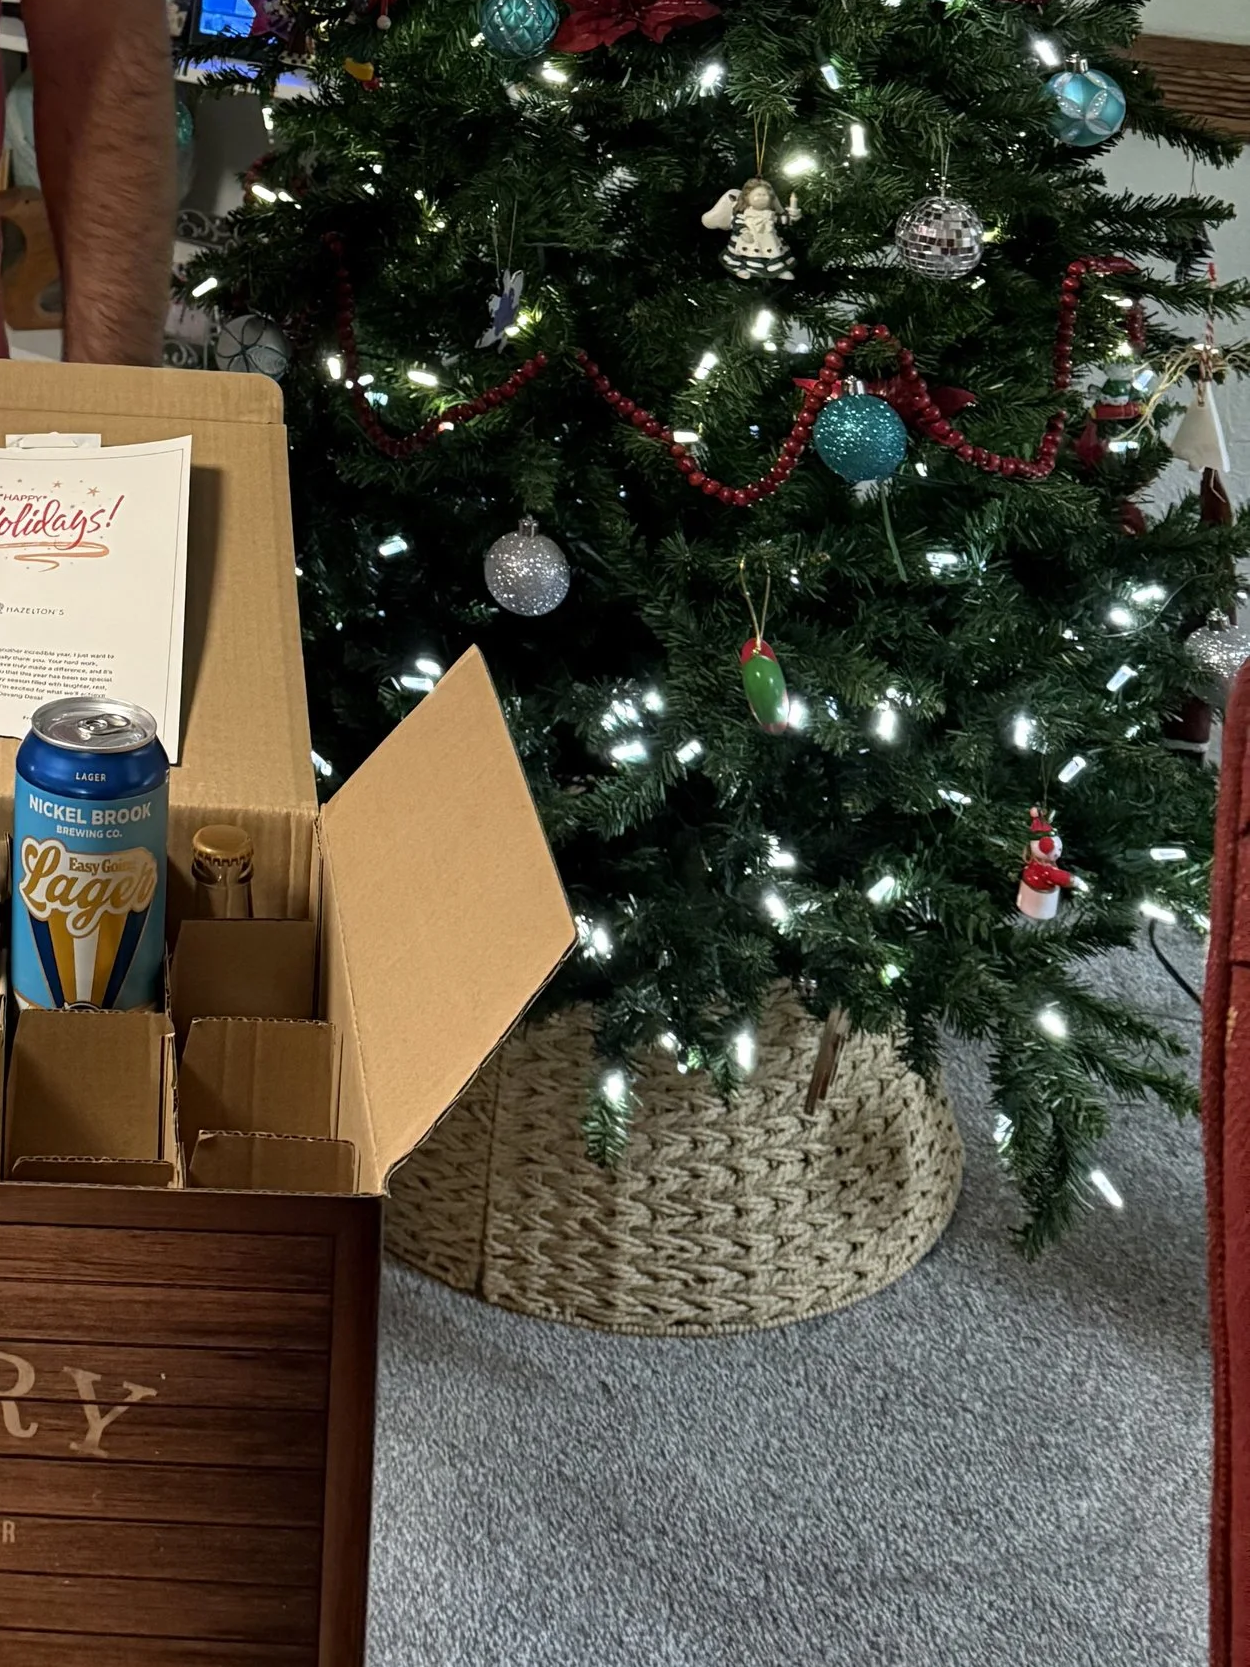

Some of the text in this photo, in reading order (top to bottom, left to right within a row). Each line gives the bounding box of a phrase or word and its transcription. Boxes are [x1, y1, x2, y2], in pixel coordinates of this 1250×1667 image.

[3, 494, 43, 503] HAPPY
[75, 772, 107, 782] LAGER
[29, 794, 151, 826] NICKEL BROOK
[56, 825, 123, 839] BREWING CO.
[69, 857, 100, 876] Easy
[22, 843, 154, 930] Lager
